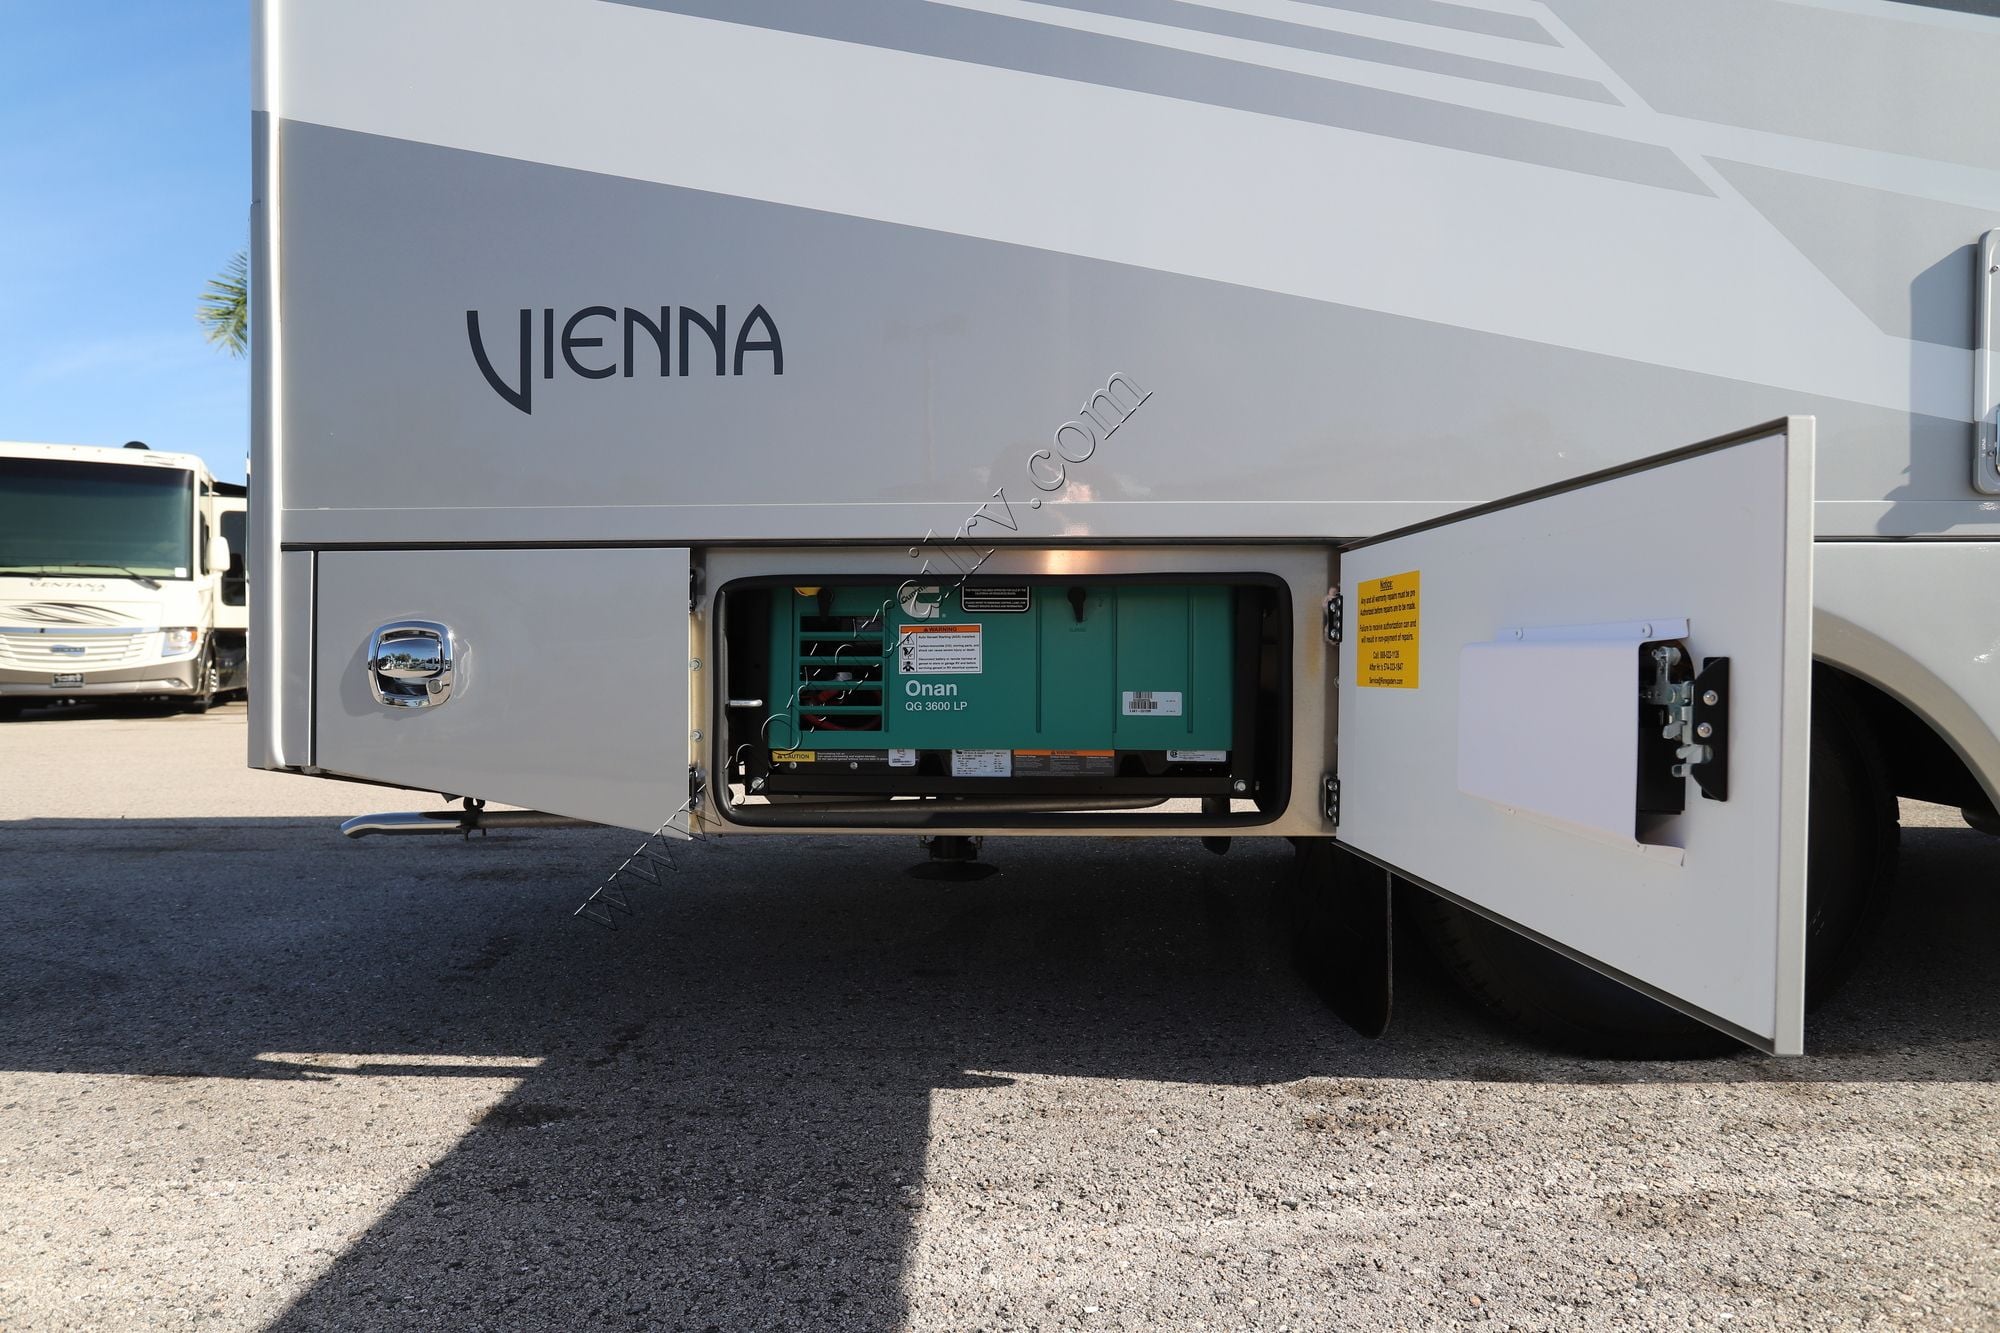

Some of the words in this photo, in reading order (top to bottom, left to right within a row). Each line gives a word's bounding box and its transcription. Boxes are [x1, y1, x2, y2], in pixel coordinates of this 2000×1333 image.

[467, 304, 783, 415] VIENNA
[905, 680, 957, 696] Onan
[905, 701, 922, 711] QG
[925, 701, 950, 711] 3600
[953, 701, 968, 711] LP
